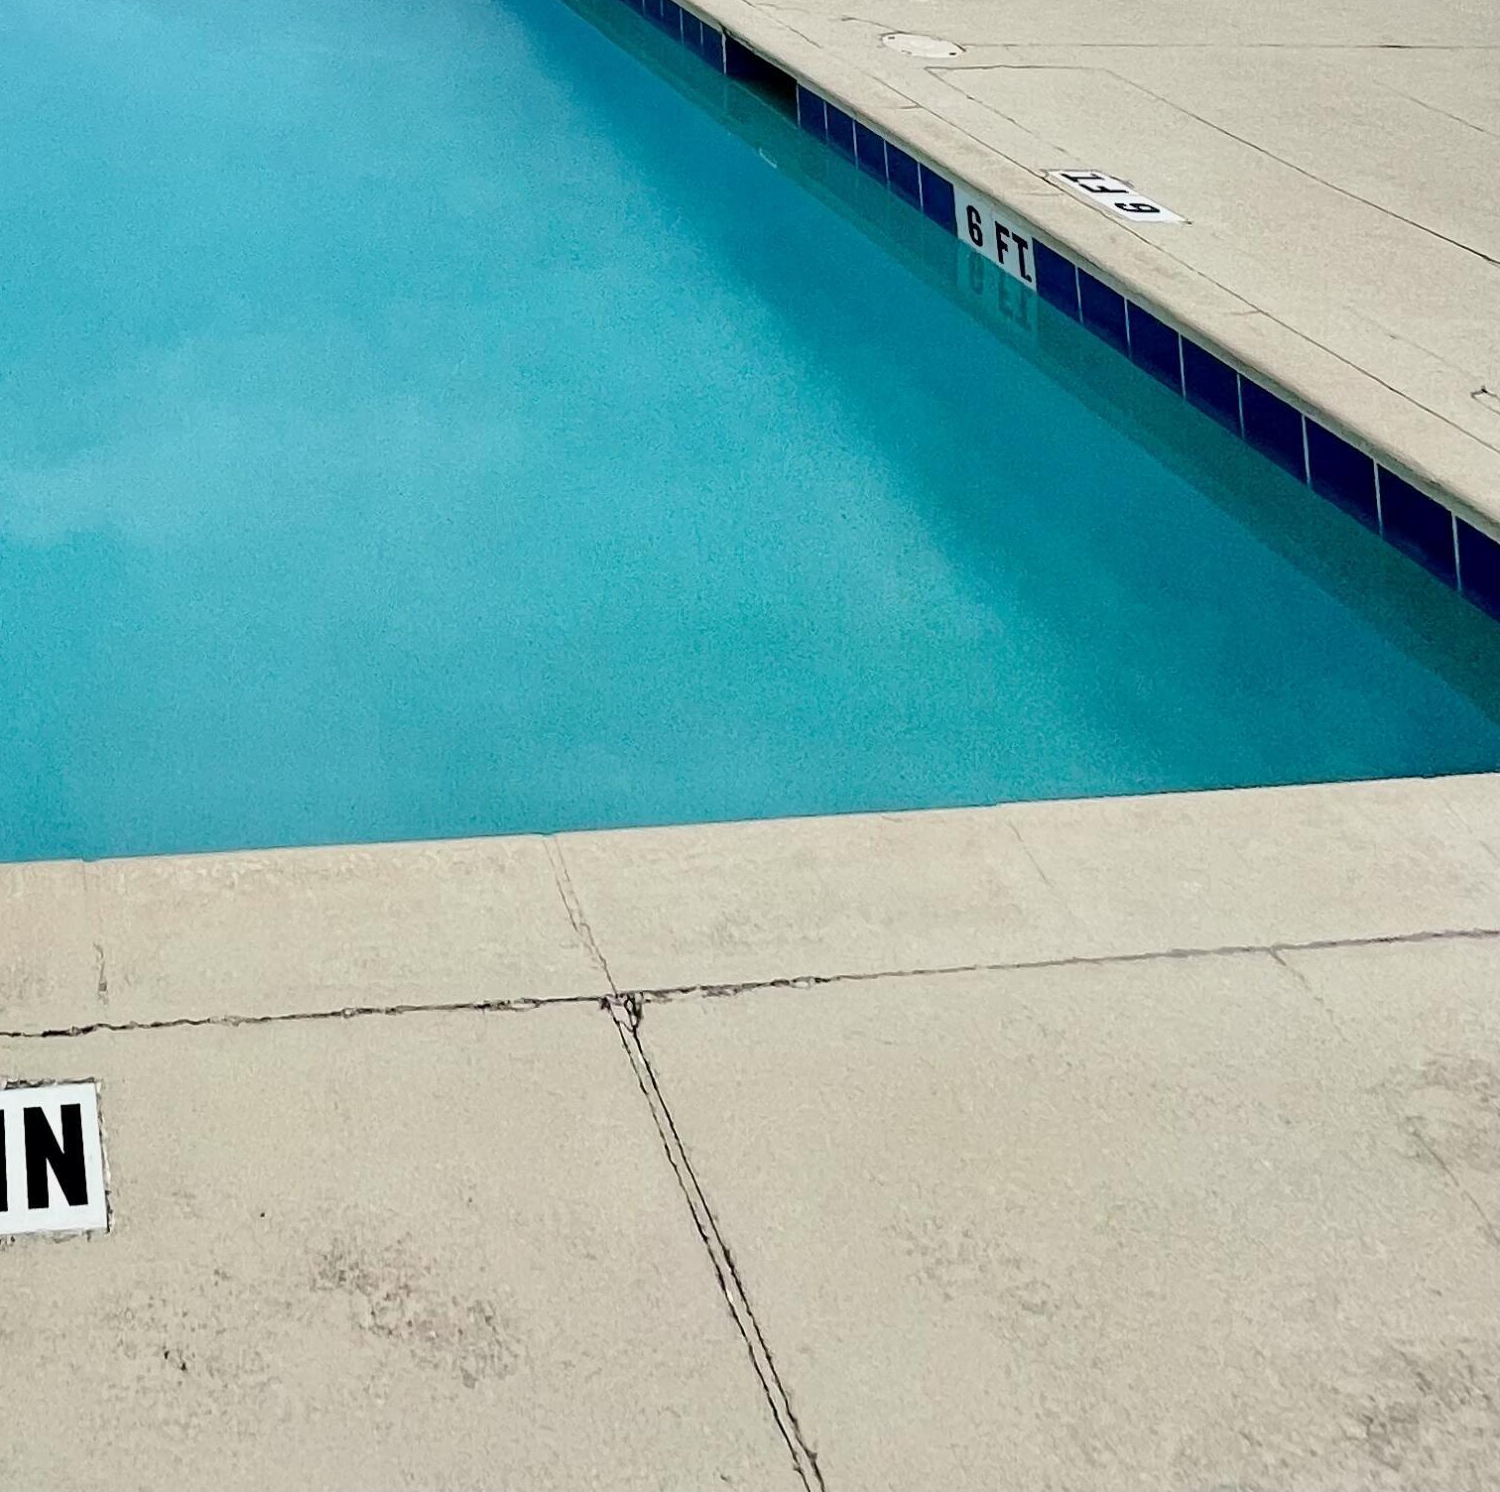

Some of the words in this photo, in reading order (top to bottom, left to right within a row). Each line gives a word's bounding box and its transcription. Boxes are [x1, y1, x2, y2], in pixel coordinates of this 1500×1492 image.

[1114, 202, 1161, 214] 6
[965, 204, 983, 248] 6
[994, 220, 1032, 283] FT.
